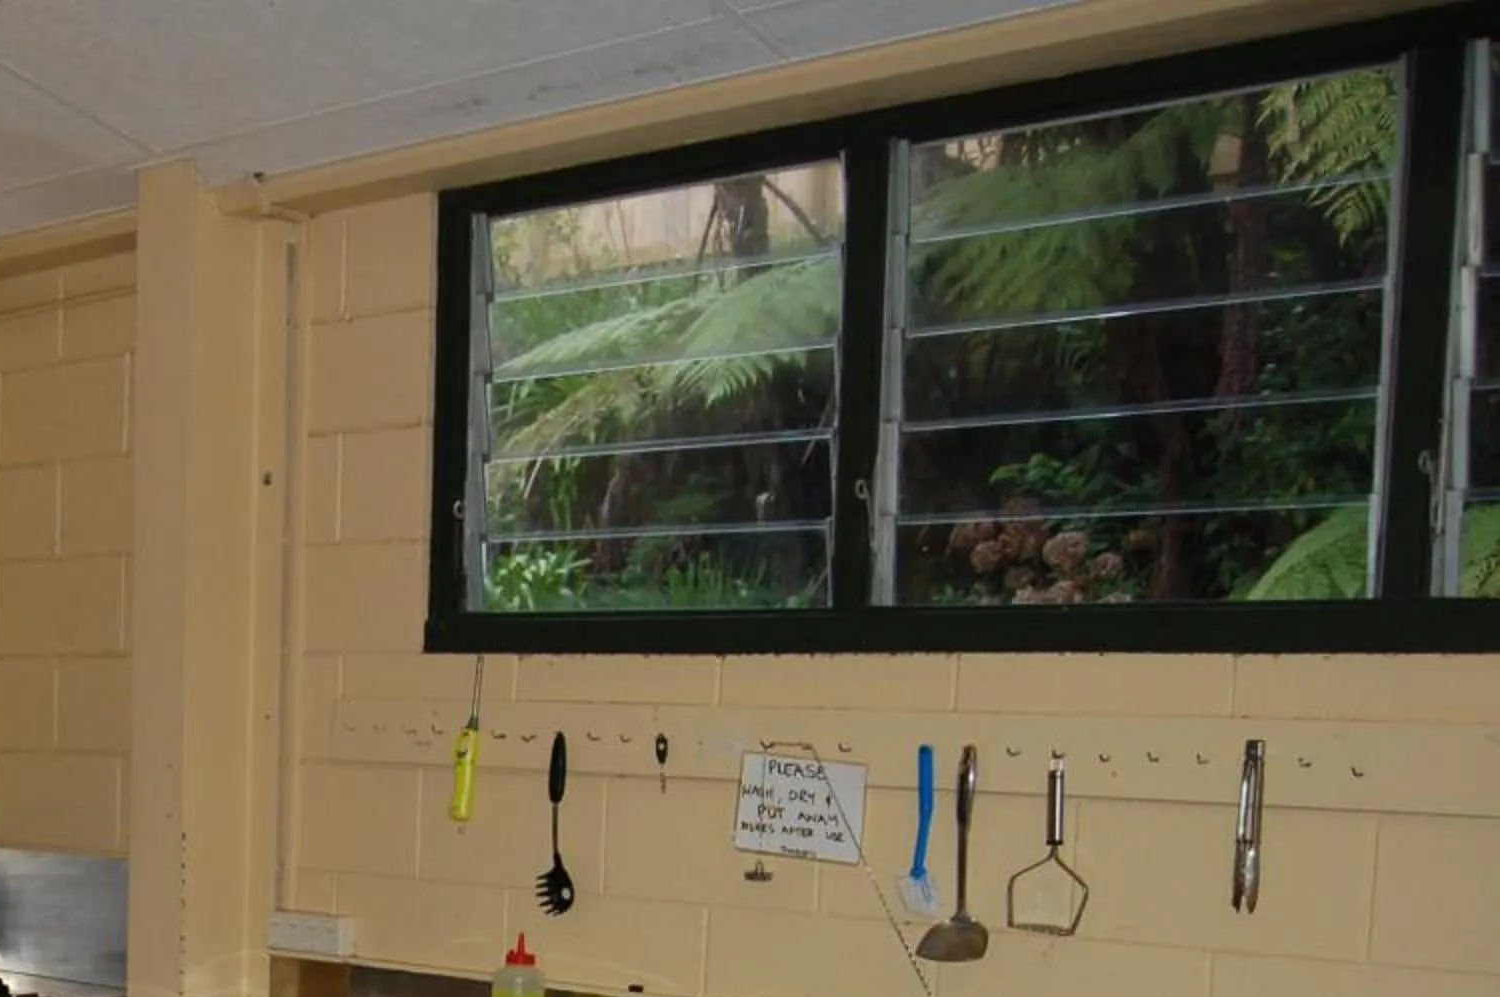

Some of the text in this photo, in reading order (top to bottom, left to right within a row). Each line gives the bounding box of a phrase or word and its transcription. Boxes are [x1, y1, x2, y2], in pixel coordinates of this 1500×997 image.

[768, 759, 827, 781] PLEASE
[787, 789, 815, 805] DRY
[757, 802, 839, 827] PUT AWAY
